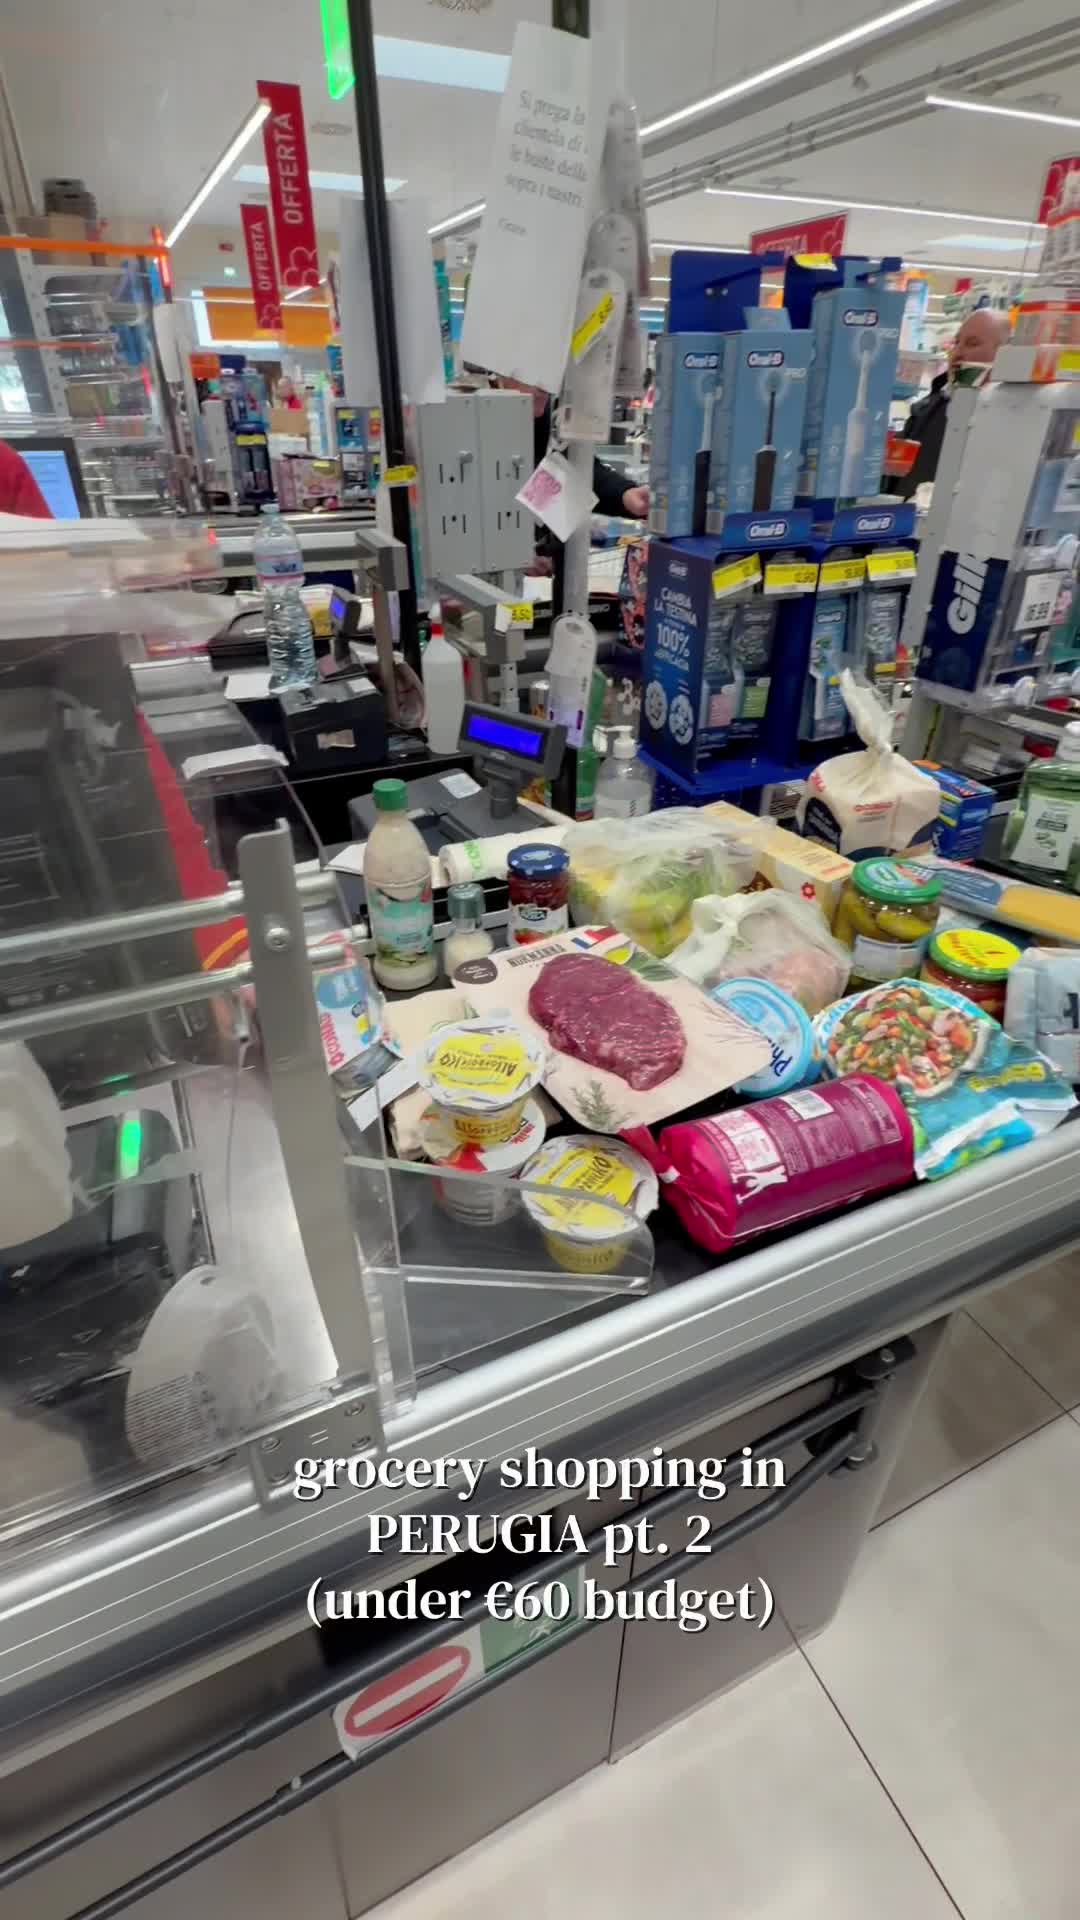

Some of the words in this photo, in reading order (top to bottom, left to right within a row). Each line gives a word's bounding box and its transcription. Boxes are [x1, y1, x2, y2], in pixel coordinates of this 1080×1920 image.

[272, 112, 304, 225] OFFERTA
[250, 220, 274, 292] OFFERTA
[750, 521, 786, 538] Oral-B
[856, 516, 891, 532] Oral-B
[656, 623, 691, 657] 100%
